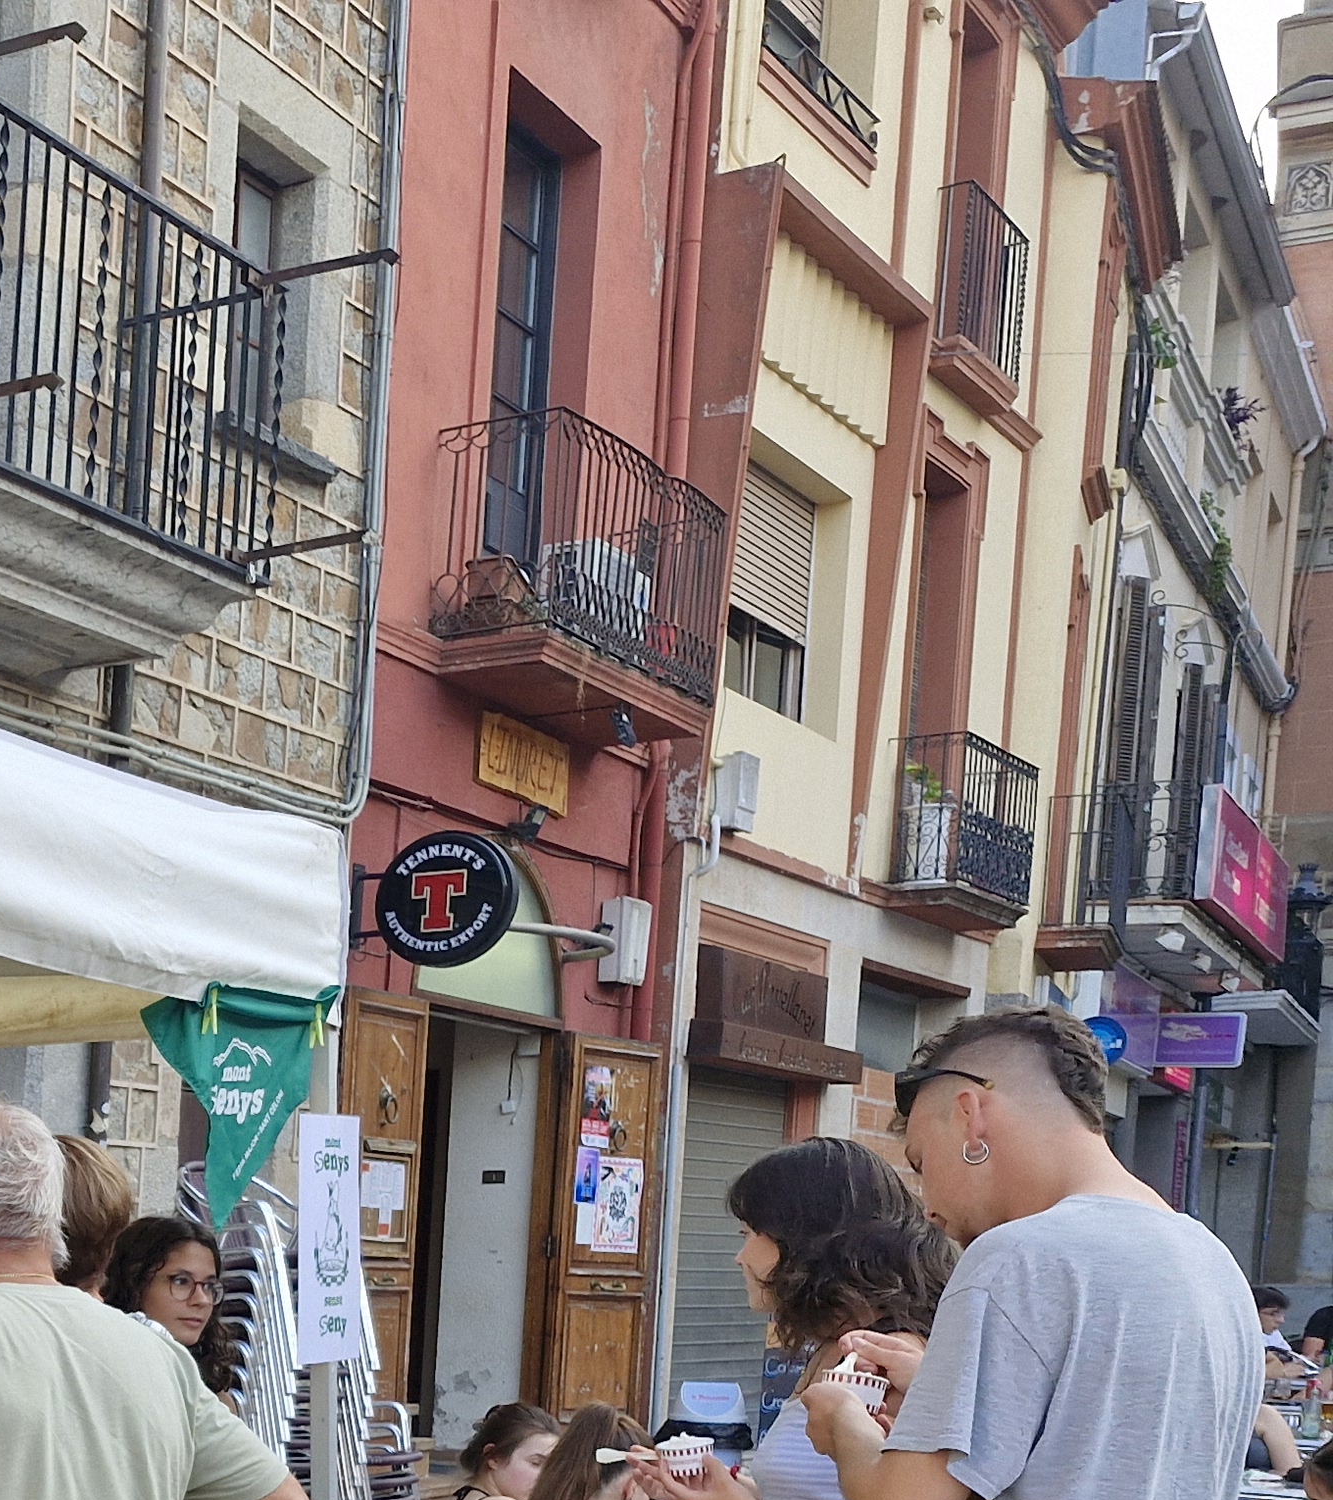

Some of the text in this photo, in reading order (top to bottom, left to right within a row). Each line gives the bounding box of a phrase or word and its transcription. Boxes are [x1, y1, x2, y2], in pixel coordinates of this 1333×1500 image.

[395, 843, 487, 876] TENNENT'S
[411, 868, 468, 933] T
[385, 902, 493, 951] AUTHENTIC EXPORT
[221, 1064, 252, 1082] mont
[313, 1150, 350, 1177] Senys
[318, 1315, 347, 1338] Seny
